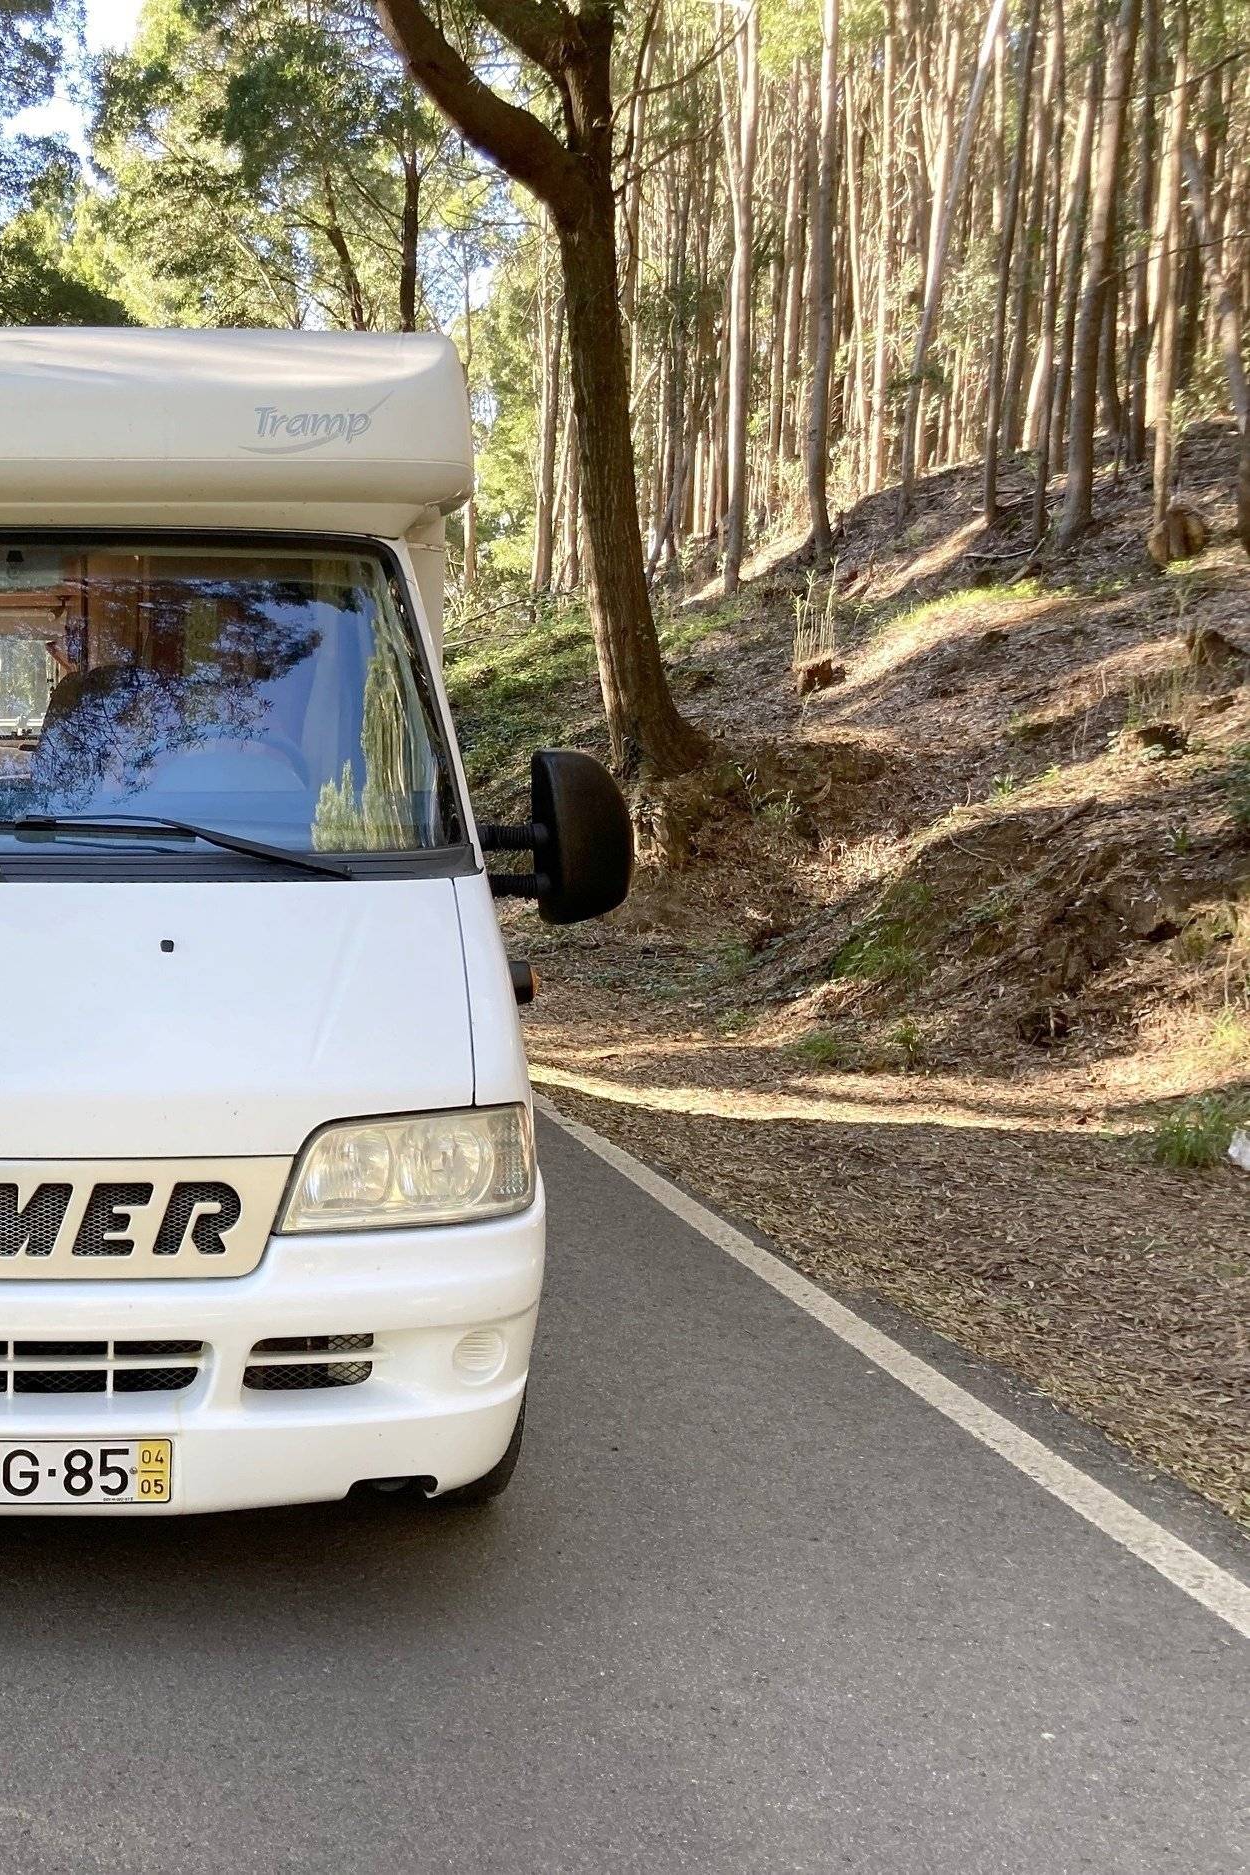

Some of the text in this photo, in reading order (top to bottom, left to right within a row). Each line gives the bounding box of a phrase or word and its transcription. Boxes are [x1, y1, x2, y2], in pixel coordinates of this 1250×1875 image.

[254, 406, 372, 444] Tramp
[141, 1449, 164, 1464] 04
[141, 1479, 164, 1495] 05
